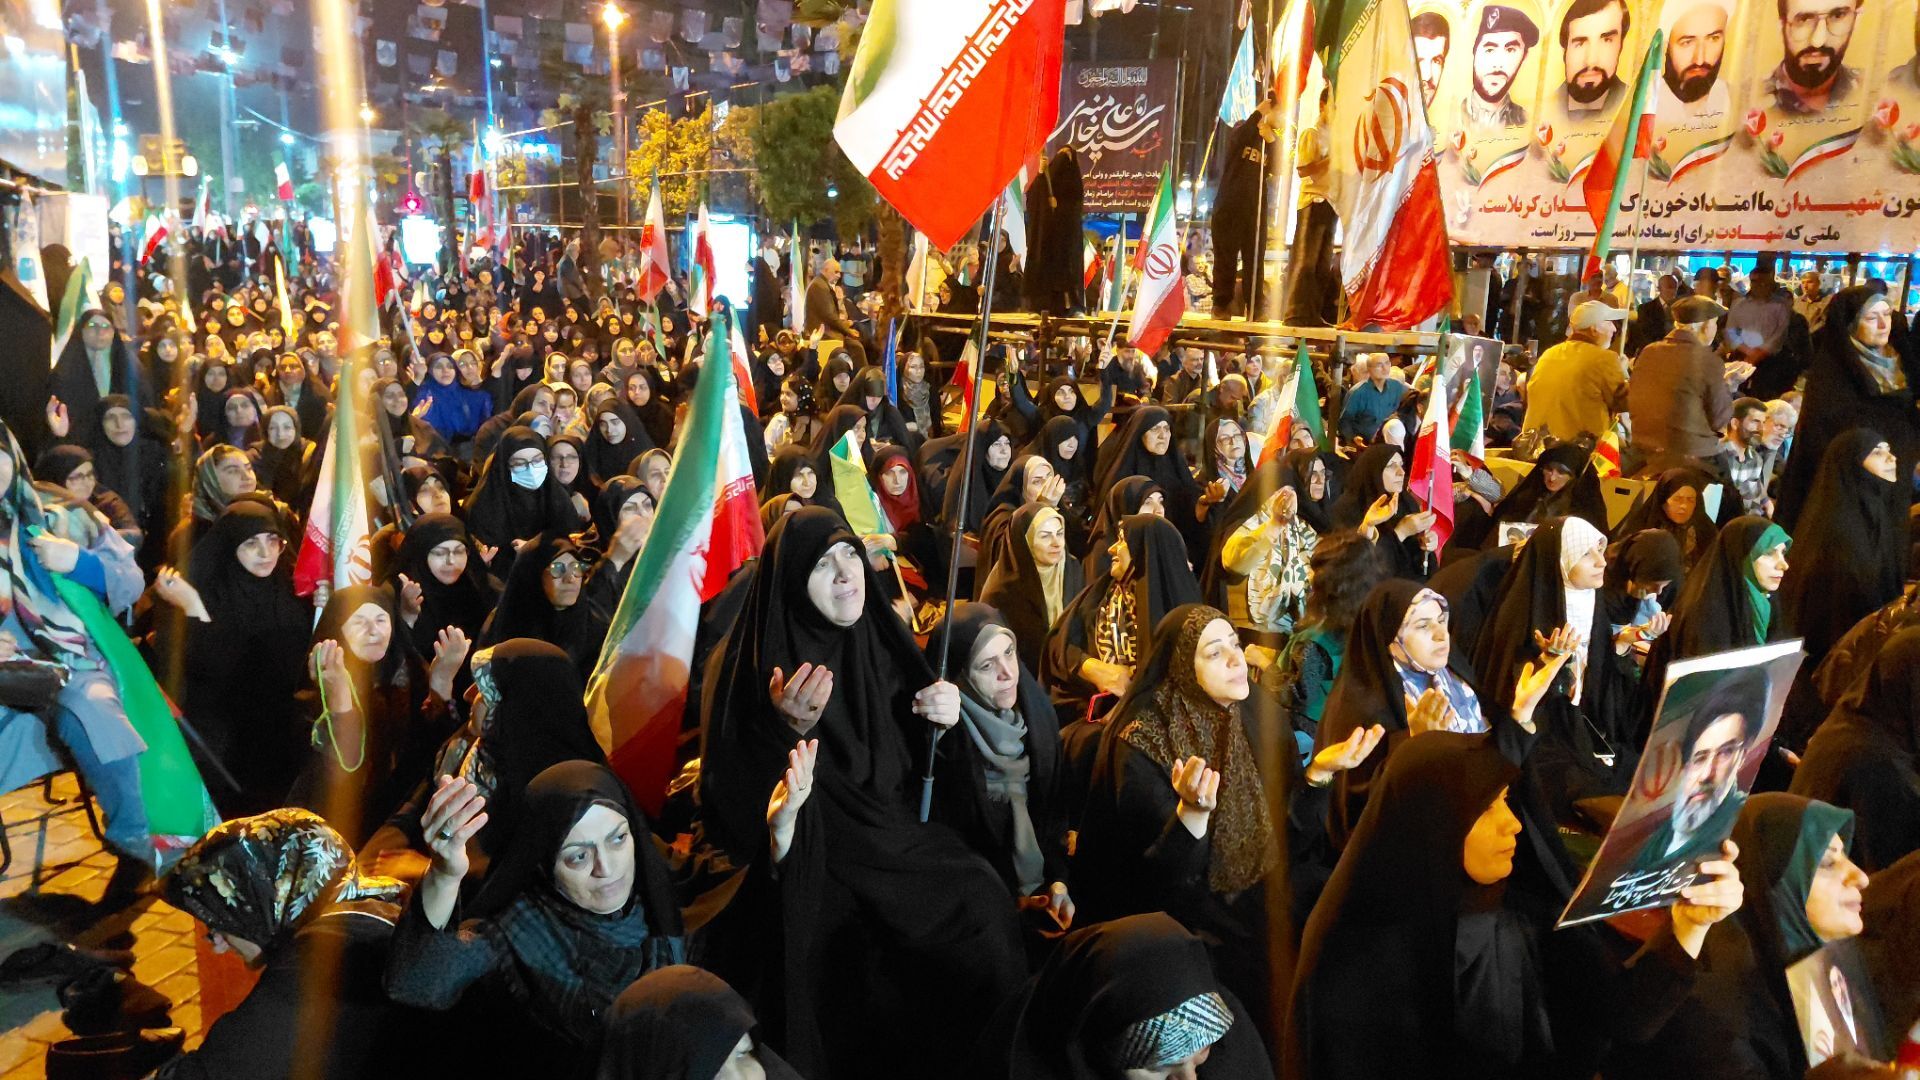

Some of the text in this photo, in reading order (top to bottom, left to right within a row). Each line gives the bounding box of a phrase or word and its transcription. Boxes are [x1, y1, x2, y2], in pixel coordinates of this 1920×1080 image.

[1619, 193, 1649, 219] پک
[1650, 192, 1688, 218] خون
[1689, 191, 1758, 212] امتداد
[1758, 191, 1774, 211] ما
[1775, 189, 1883, 218] شهیدان
[1672, 224, 1685, 243] او
[1685, 224, 1715, 244] برای
[1716, 225, 1785, 243] شهادت
[1785, 225, 1804, 240] که
[1803, 225, 1840, 246] ملتی
